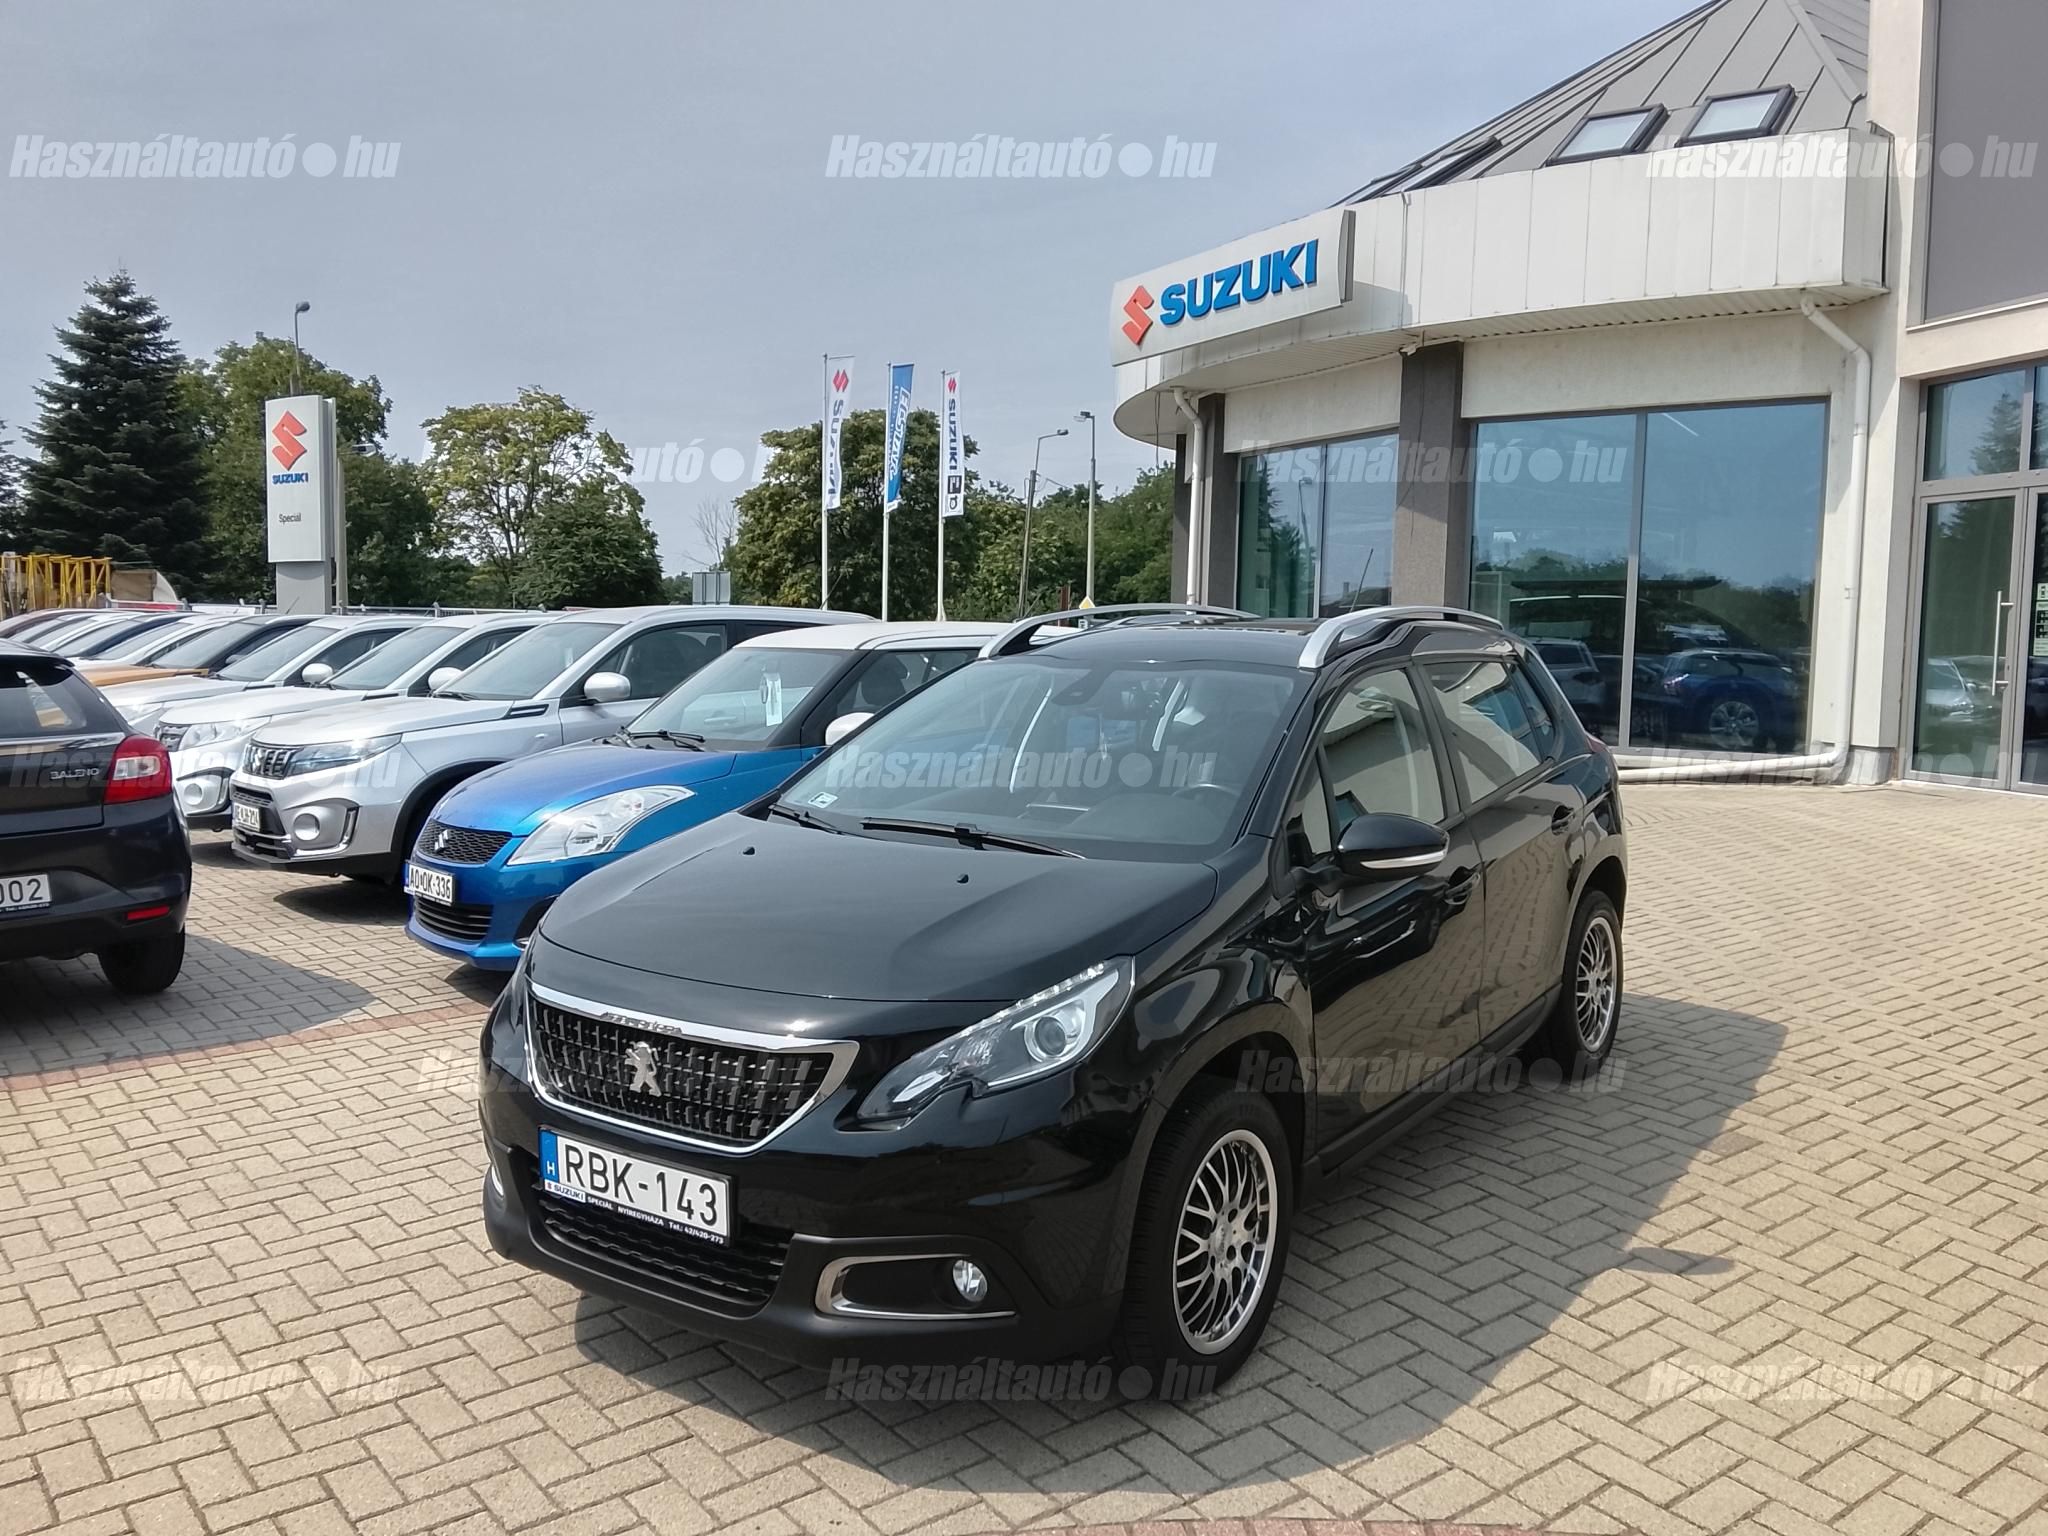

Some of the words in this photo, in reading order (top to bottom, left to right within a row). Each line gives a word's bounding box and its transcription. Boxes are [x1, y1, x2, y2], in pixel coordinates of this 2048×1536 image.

[1160, 239, 1319, 326] SUZUKI
[948, 398, 958, 470] SUZUKI
[272, 472, 309, 485] SUZUKI
[279, 513, 302, 525] Special
[546, 1160, 556, 1176] H
[553, 1183, 584, 1200] SUZUKI
[565, 1144, 717, 1226] RBK-143
